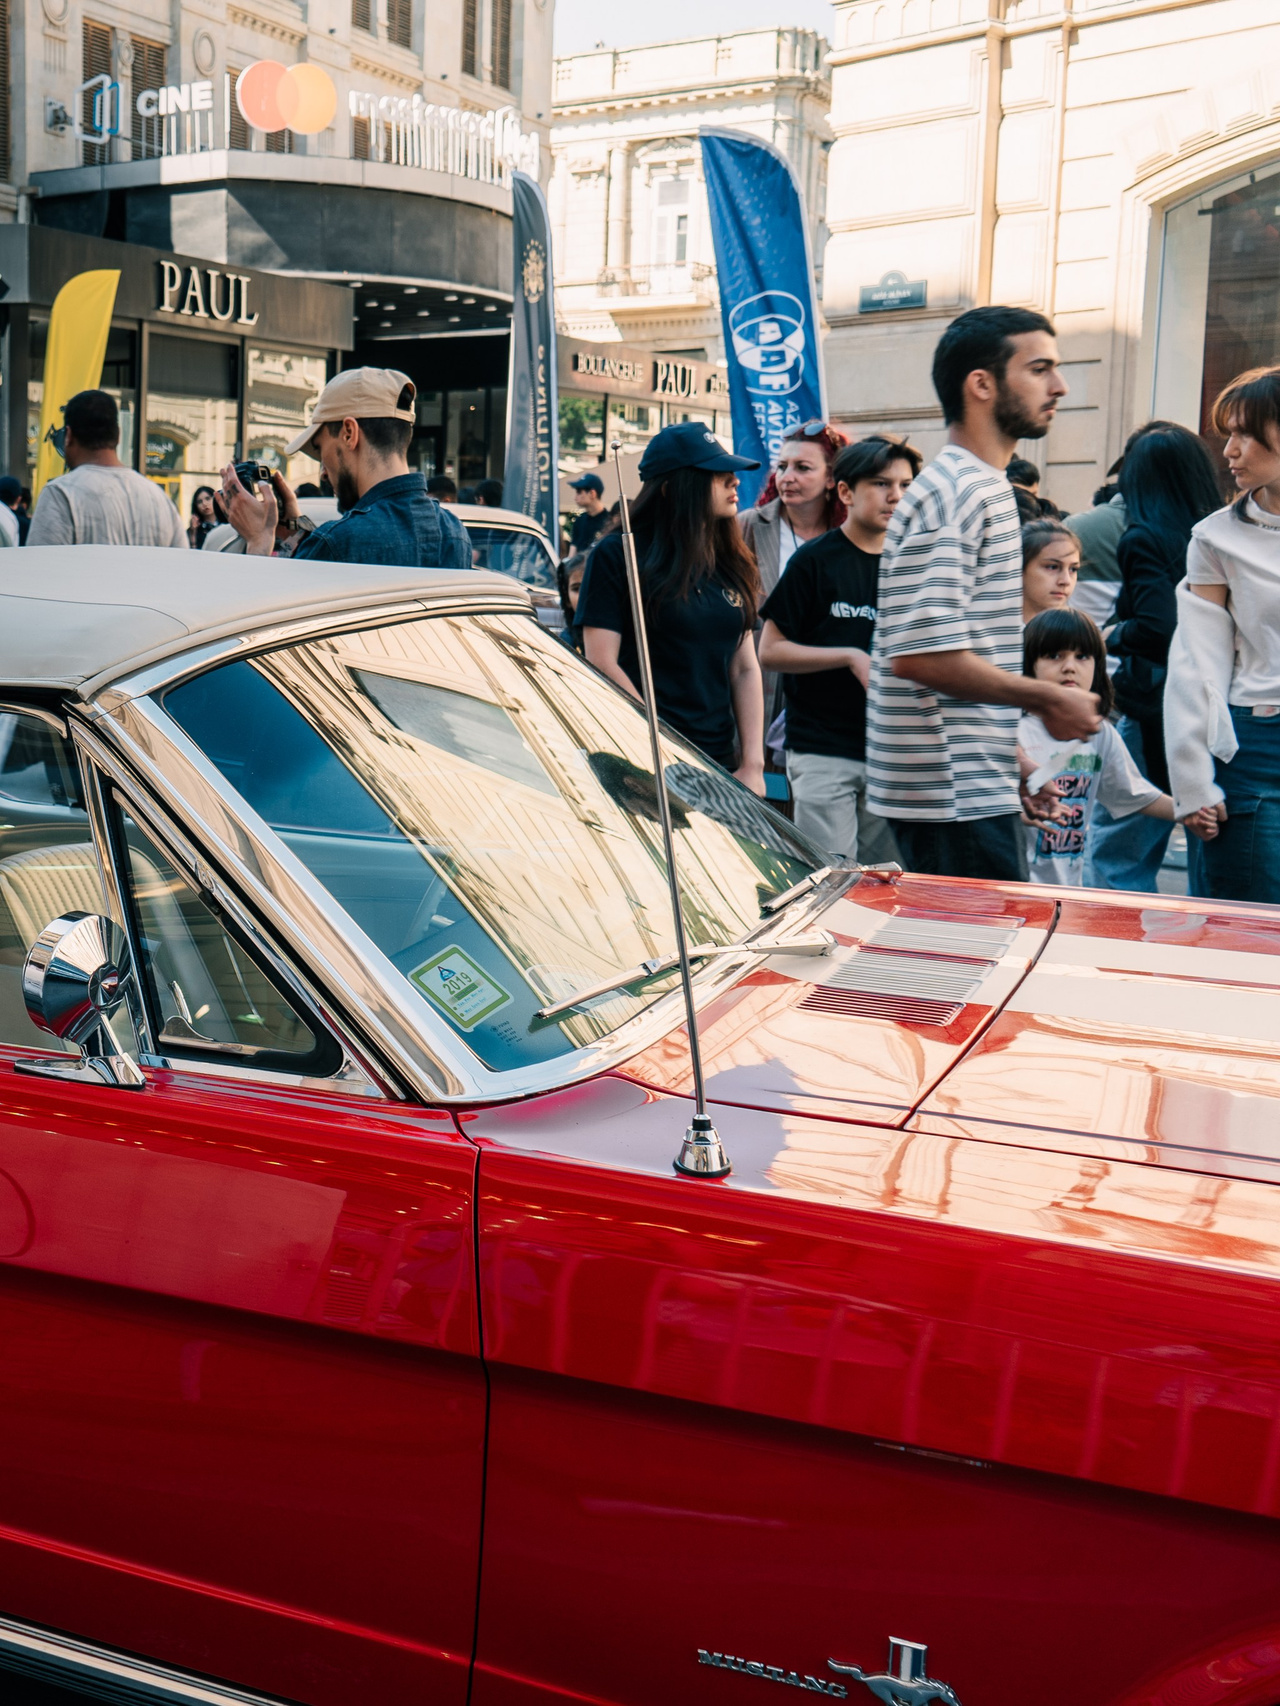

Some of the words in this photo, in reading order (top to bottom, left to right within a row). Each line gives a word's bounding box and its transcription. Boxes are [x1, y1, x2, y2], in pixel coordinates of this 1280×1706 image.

[136, 81, 213, 117] CINE
[160, 260, 260, 326] PAUL
[577, 352, 644, 383] BOULANGERIE
[656, 359, 698, 399] PAUL
[759, 322, 791, 390] AAF
[443, 972, 472, 995] 2019
[697, 1648, 849, 1699] MUSTANG
